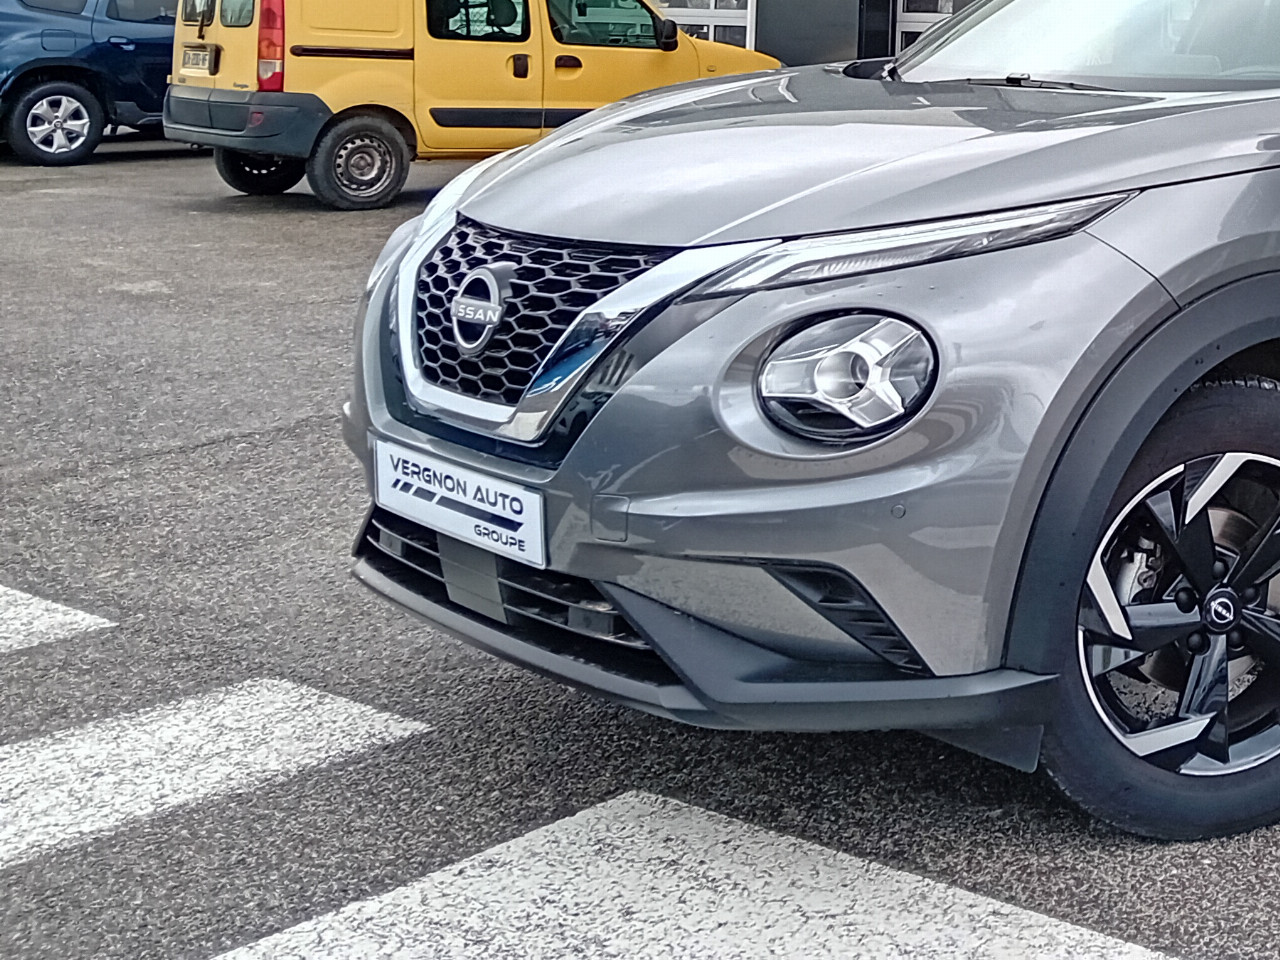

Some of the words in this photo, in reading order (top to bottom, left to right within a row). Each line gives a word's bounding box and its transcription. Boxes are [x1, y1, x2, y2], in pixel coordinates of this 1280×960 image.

[390, 454, 467, 498] VERGNON
[473, 485, 524, 516] AUTO
[473, 524, 526, 552] GROUPE
